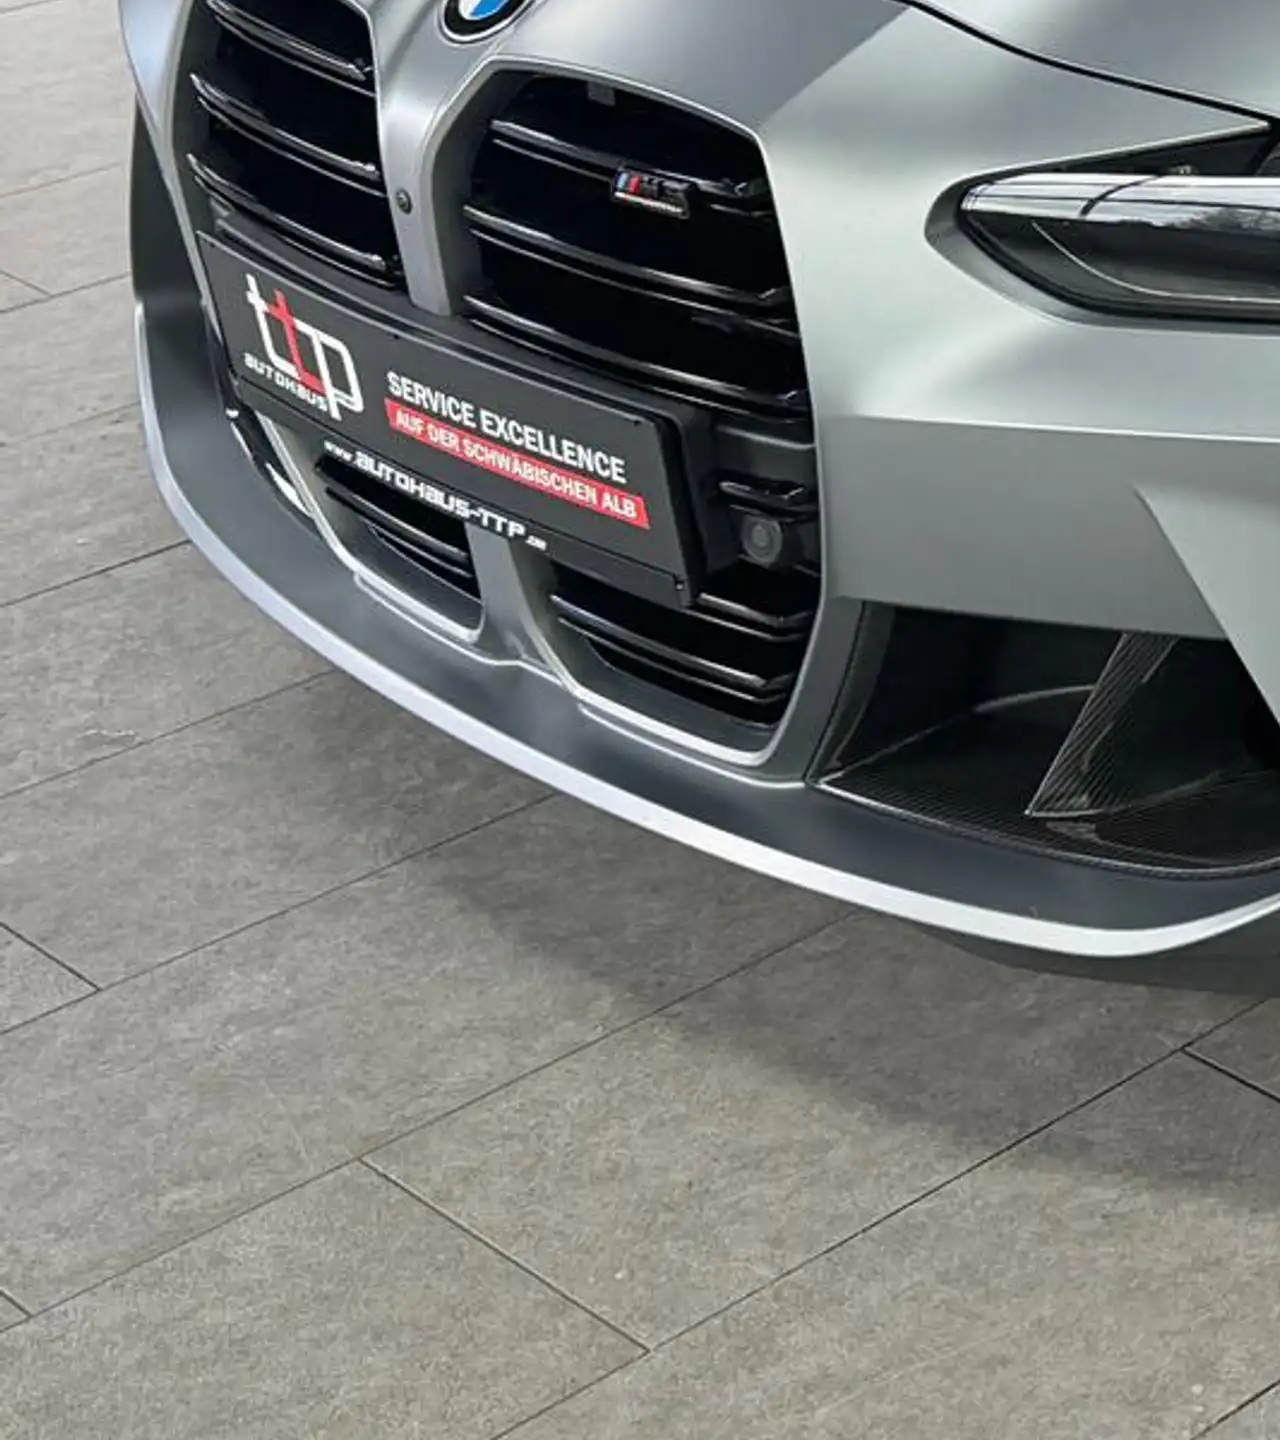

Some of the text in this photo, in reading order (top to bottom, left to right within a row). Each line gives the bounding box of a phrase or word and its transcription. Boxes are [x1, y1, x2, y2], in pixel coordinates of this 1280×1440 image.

[386, 370, 628, 485] SERVICE EXCELLENCE
[395, 410, 426, 436] AUF
[427, 422, 460, 453] DER
[601, 493, 638, 520] ALB
